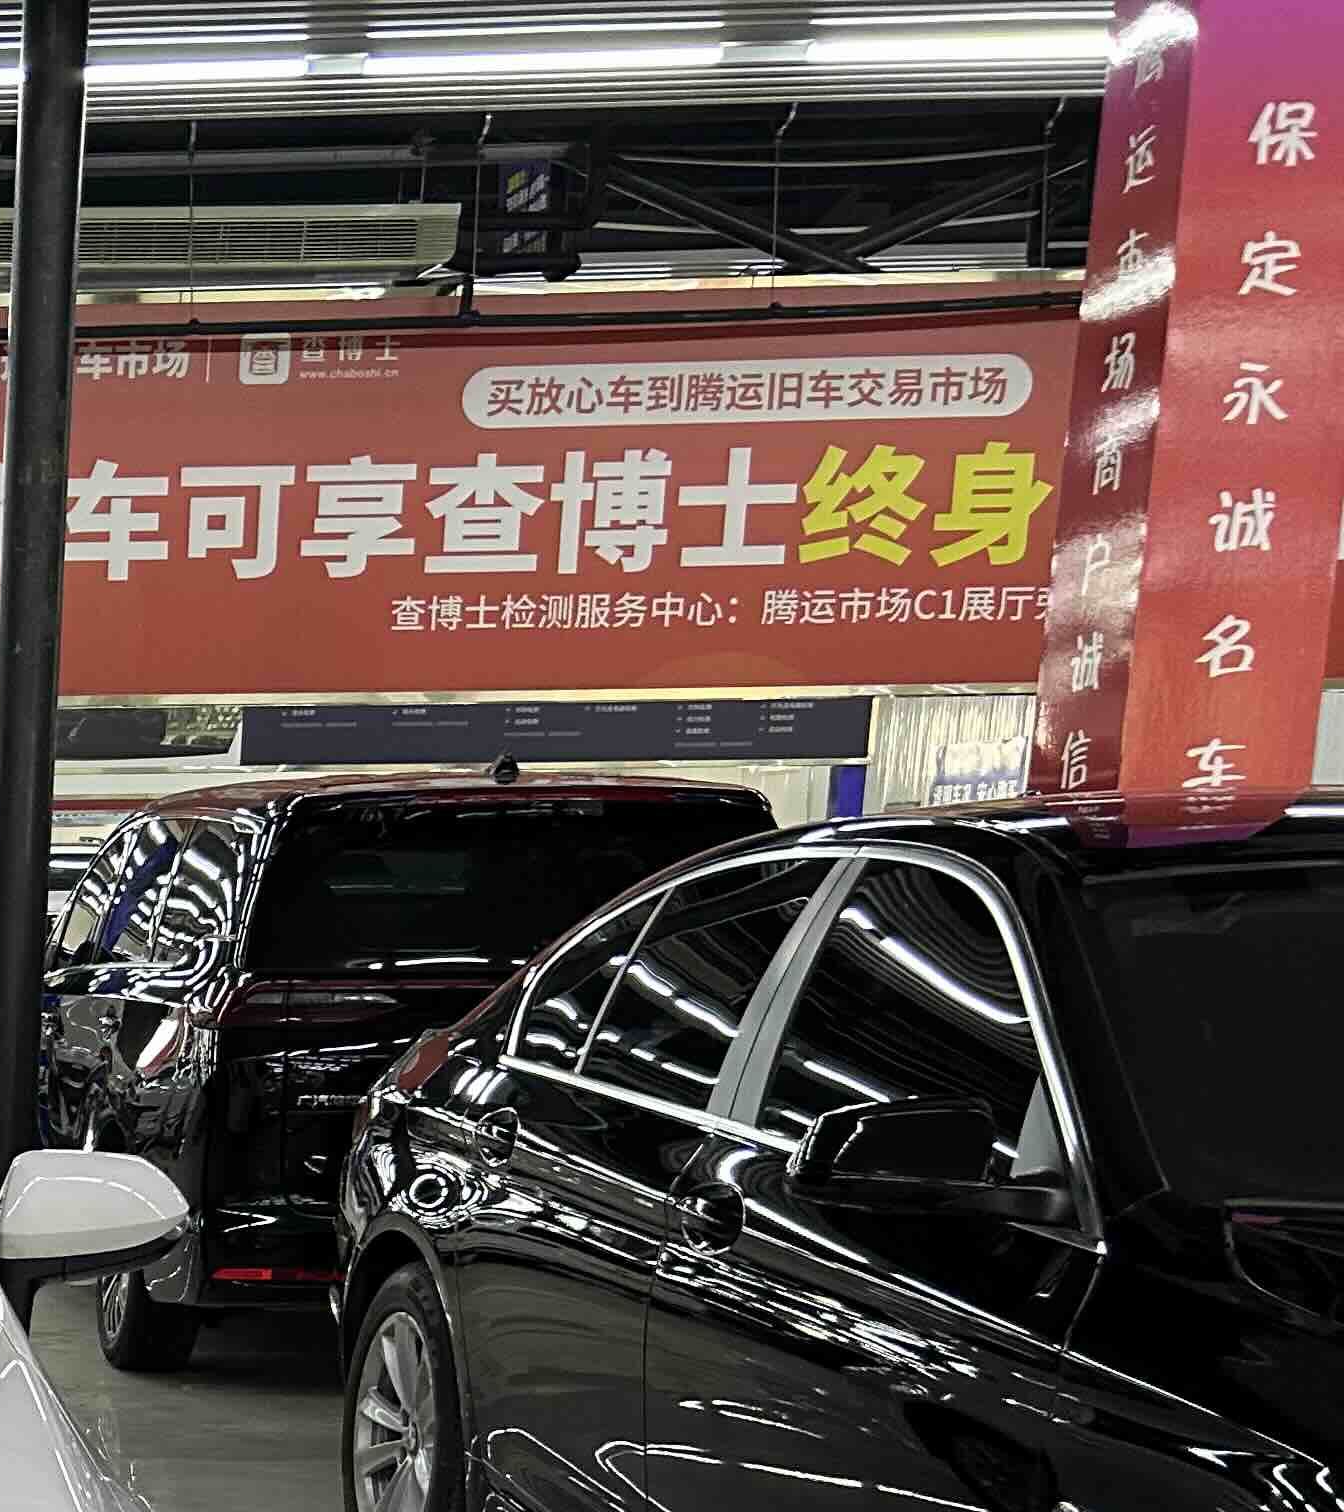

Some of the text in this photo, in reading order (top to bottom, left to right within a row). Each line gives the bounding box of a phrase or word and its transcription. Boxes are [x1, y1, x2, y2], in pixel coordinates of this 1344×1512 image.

[301, 336, 402, 362] 查博士
[486, 365, 1007, 418] 买放心车到腾运旧车交易市场
[1180, 100, 1318, 789] 保定永诚名车
